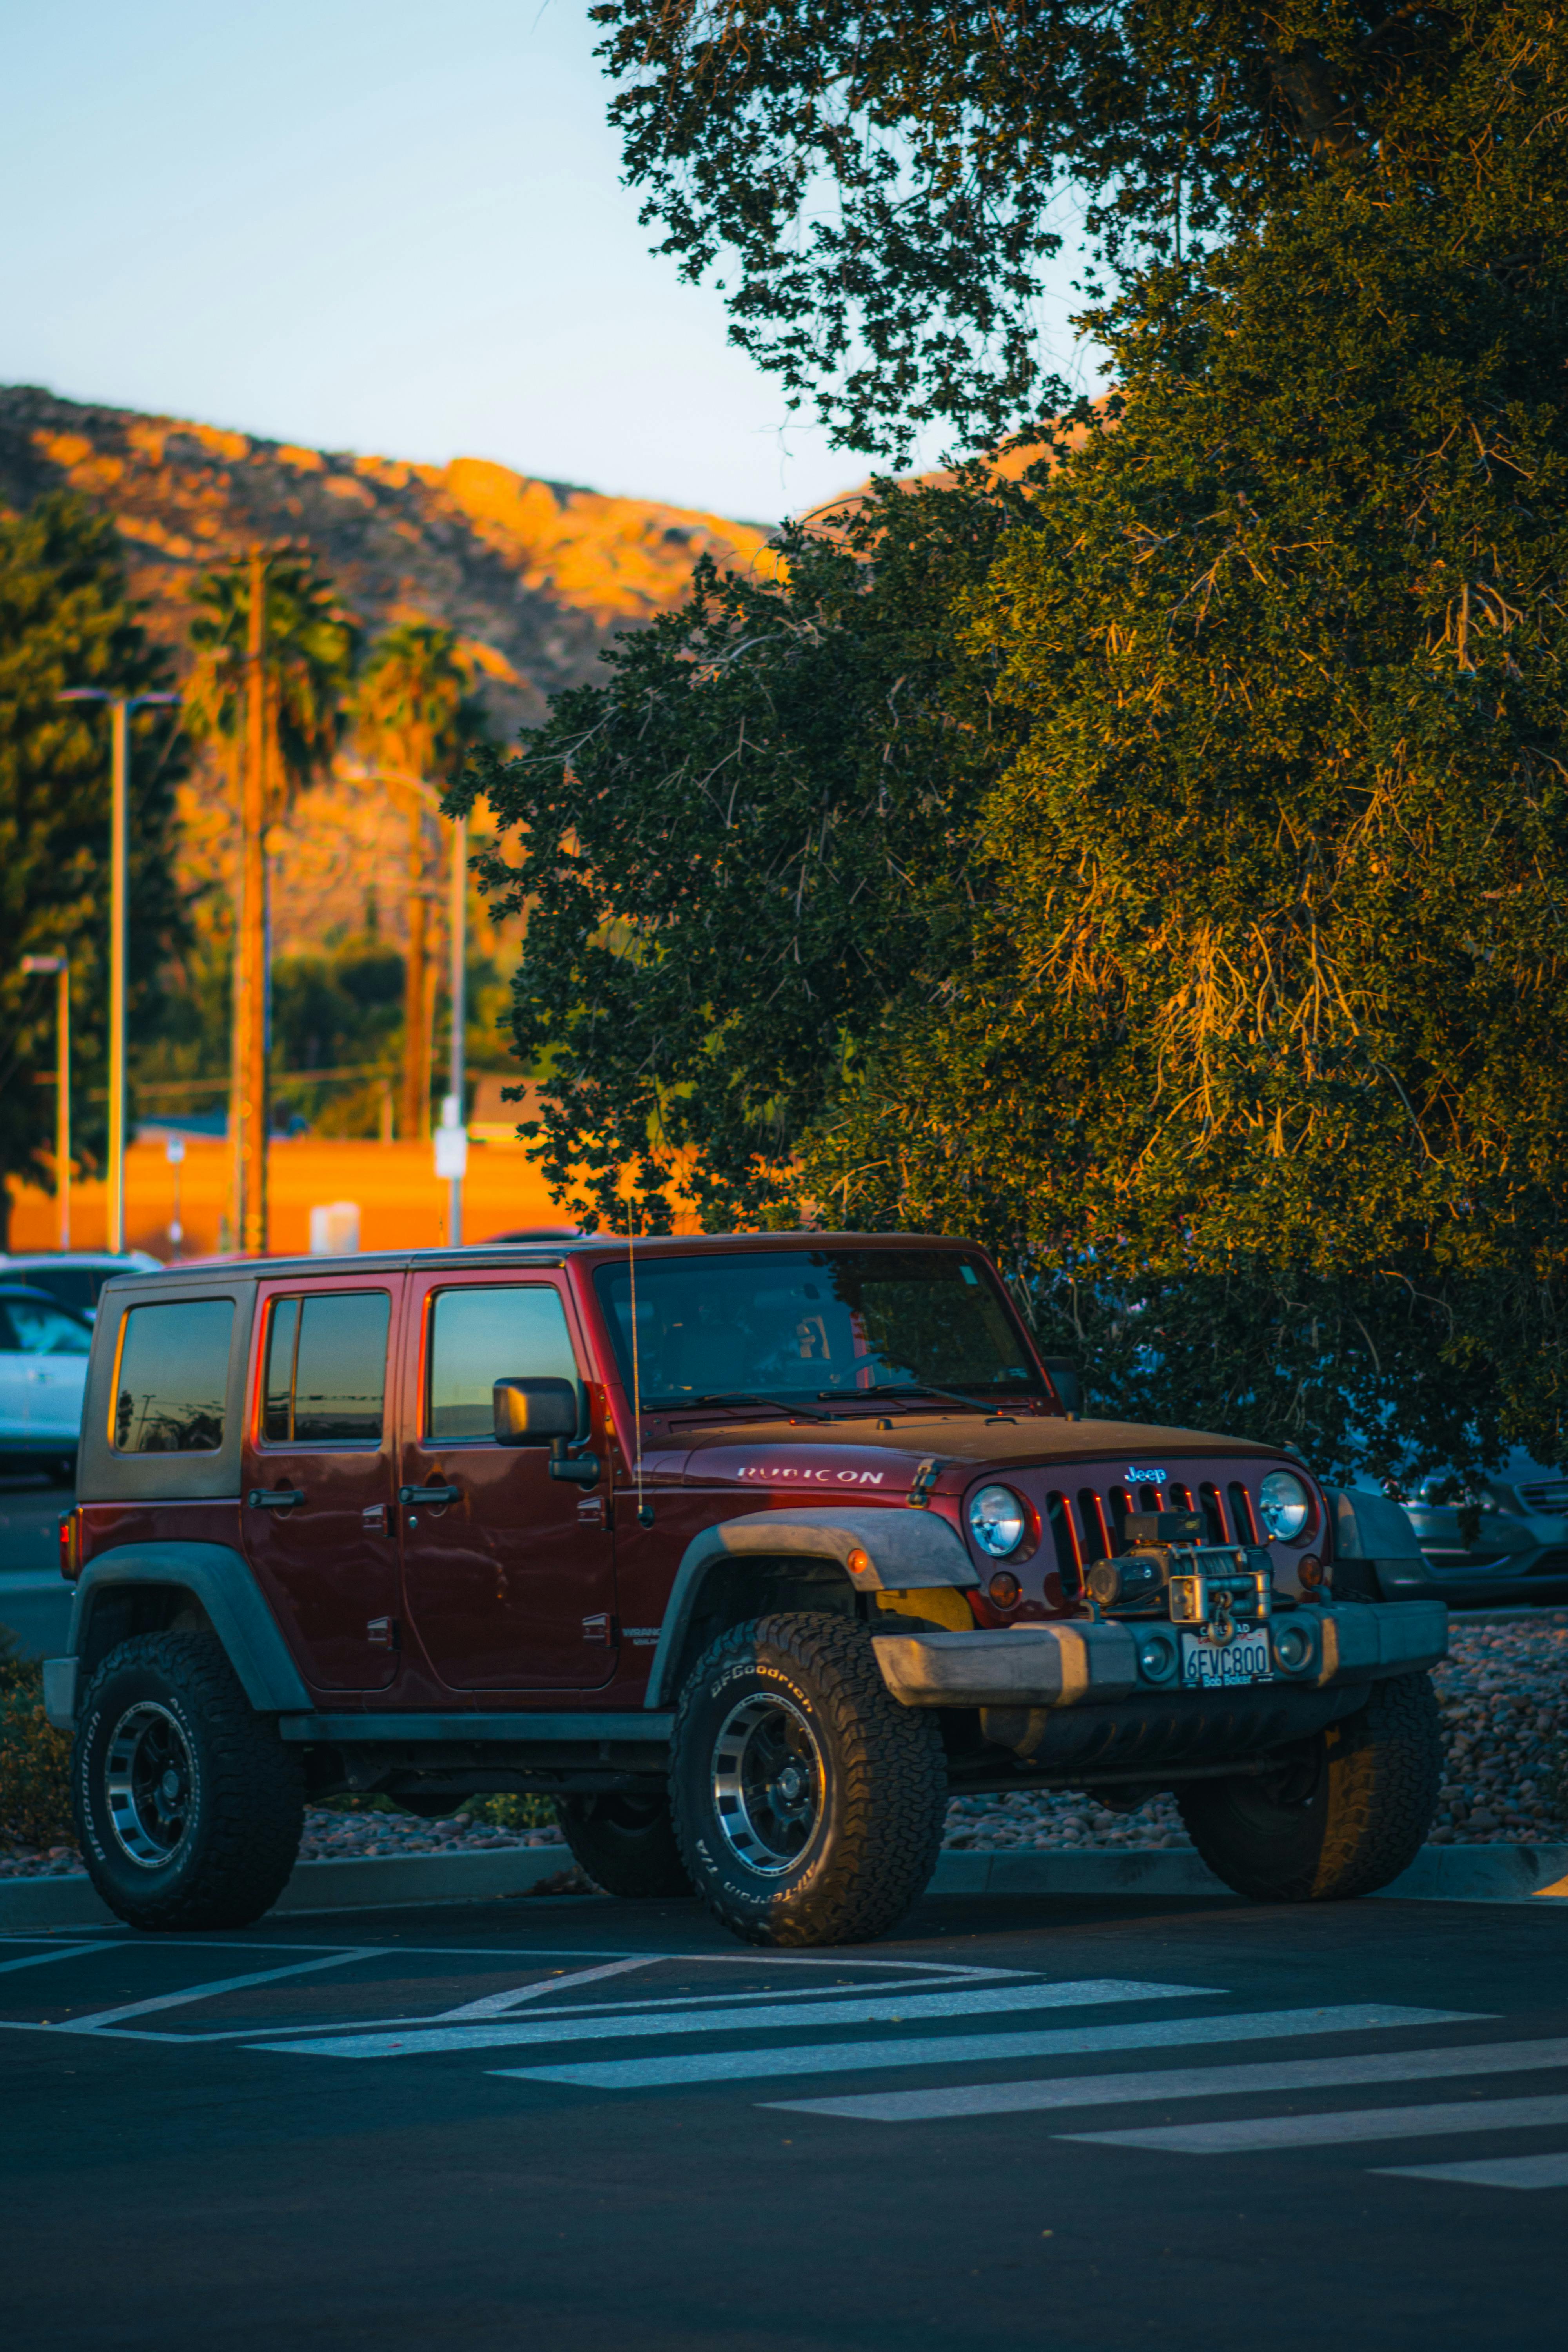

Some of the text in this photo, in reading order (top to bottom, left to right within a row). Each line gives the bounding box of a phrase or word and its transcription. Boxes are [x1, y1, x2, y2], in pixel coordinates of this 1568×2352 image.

[737, 1467, 884, 1484] RUBICON
[1124, 1466, 1167, 1484] Jeep
[1187, 1645, 1266, 1678] 6EVC800
[711, 1664, 813, 1713] BFGoodrich
[1203, 1672, 1252, 1687] Bob Baker
[82, 1711, 106, 1861] BFGoodrich
[696, 1839, 815, 1904] All-Terrain T/A
